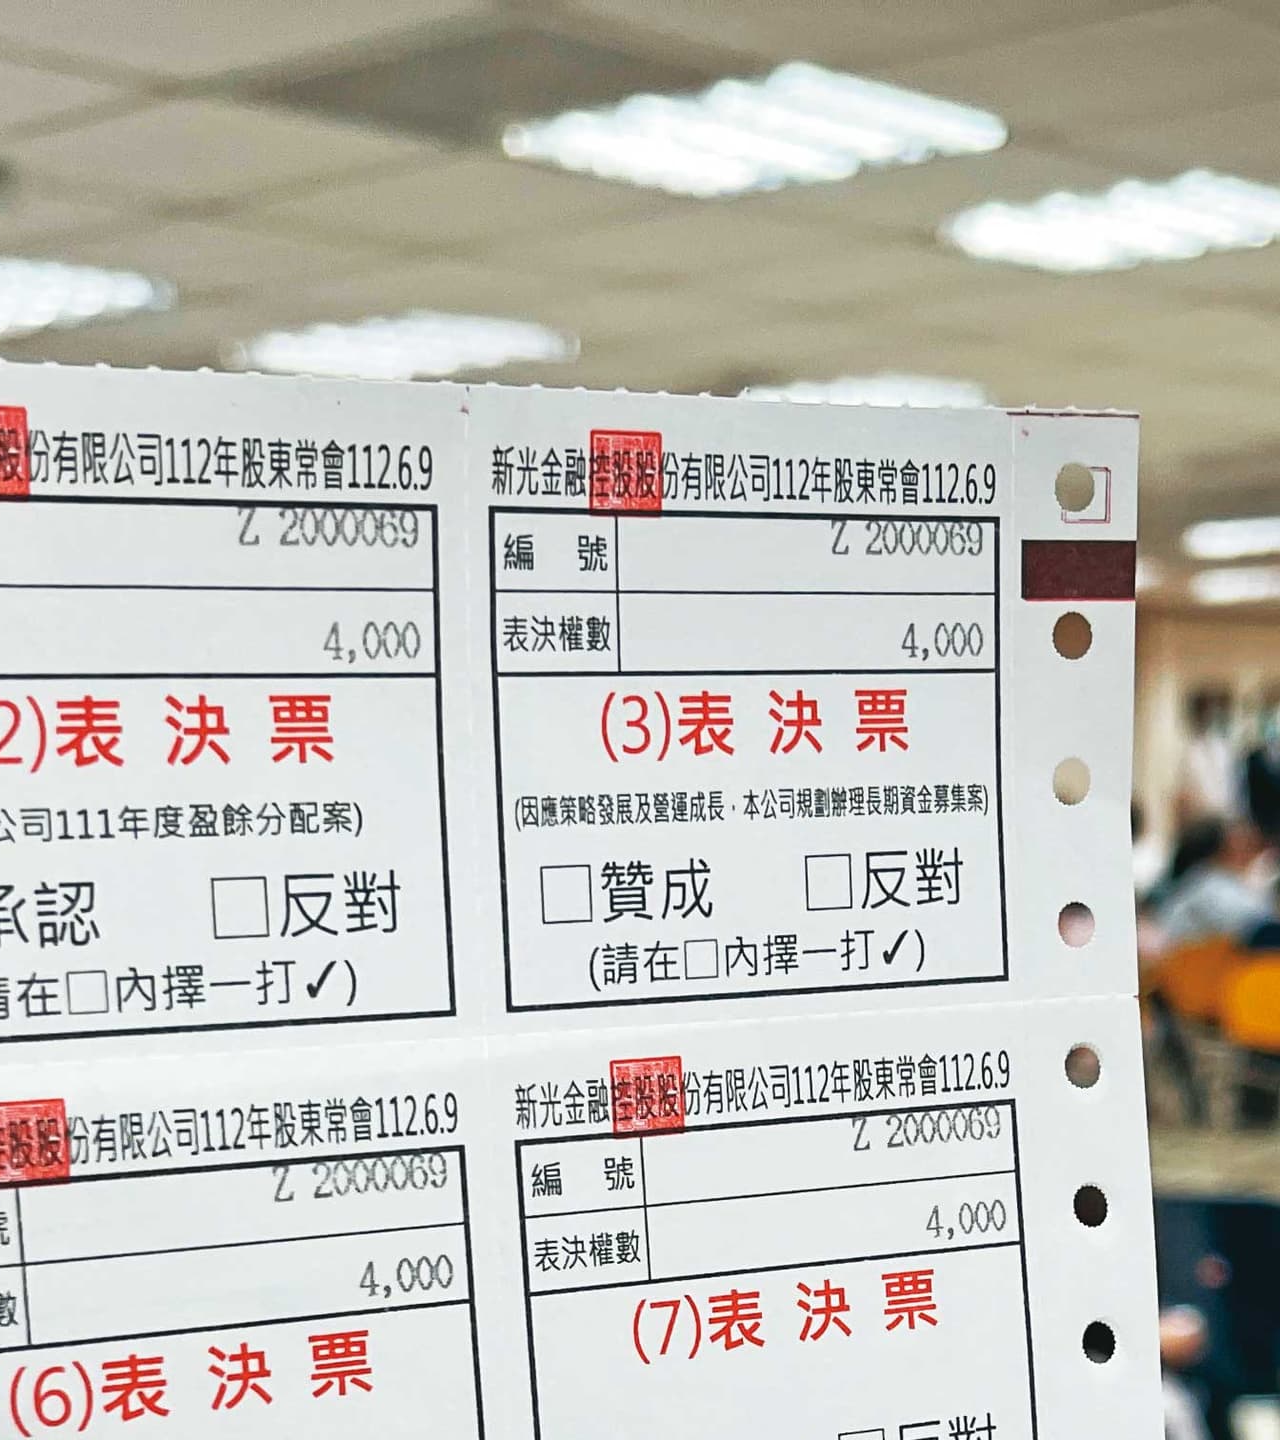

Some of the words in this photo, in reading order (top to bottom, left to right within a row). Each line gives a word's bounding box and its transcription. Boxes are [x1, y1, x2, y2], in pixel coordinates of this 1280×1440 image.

[280, 509, 420, 547] 2000069
[865, 521, 984, 556] 2000069
[323, 622, 421, 661] 4,000
[503, 615, 611, 653] 表決權數
[901, 622, 984, 659] 4,000
[601, 858, 713, 923] 贊成
[861, 847, 963, 910] 反對
[280, 869, 401, 938] 反對
[887, 1108, 1001, 1148] 2000069
[313, 1154, 448, 1198] 2000069
[926, 1200, 1006, 1239] 4,000
[534, 1232, 641, 1273] 表決權數
[360, 1254, 454, 1299] 4,000
